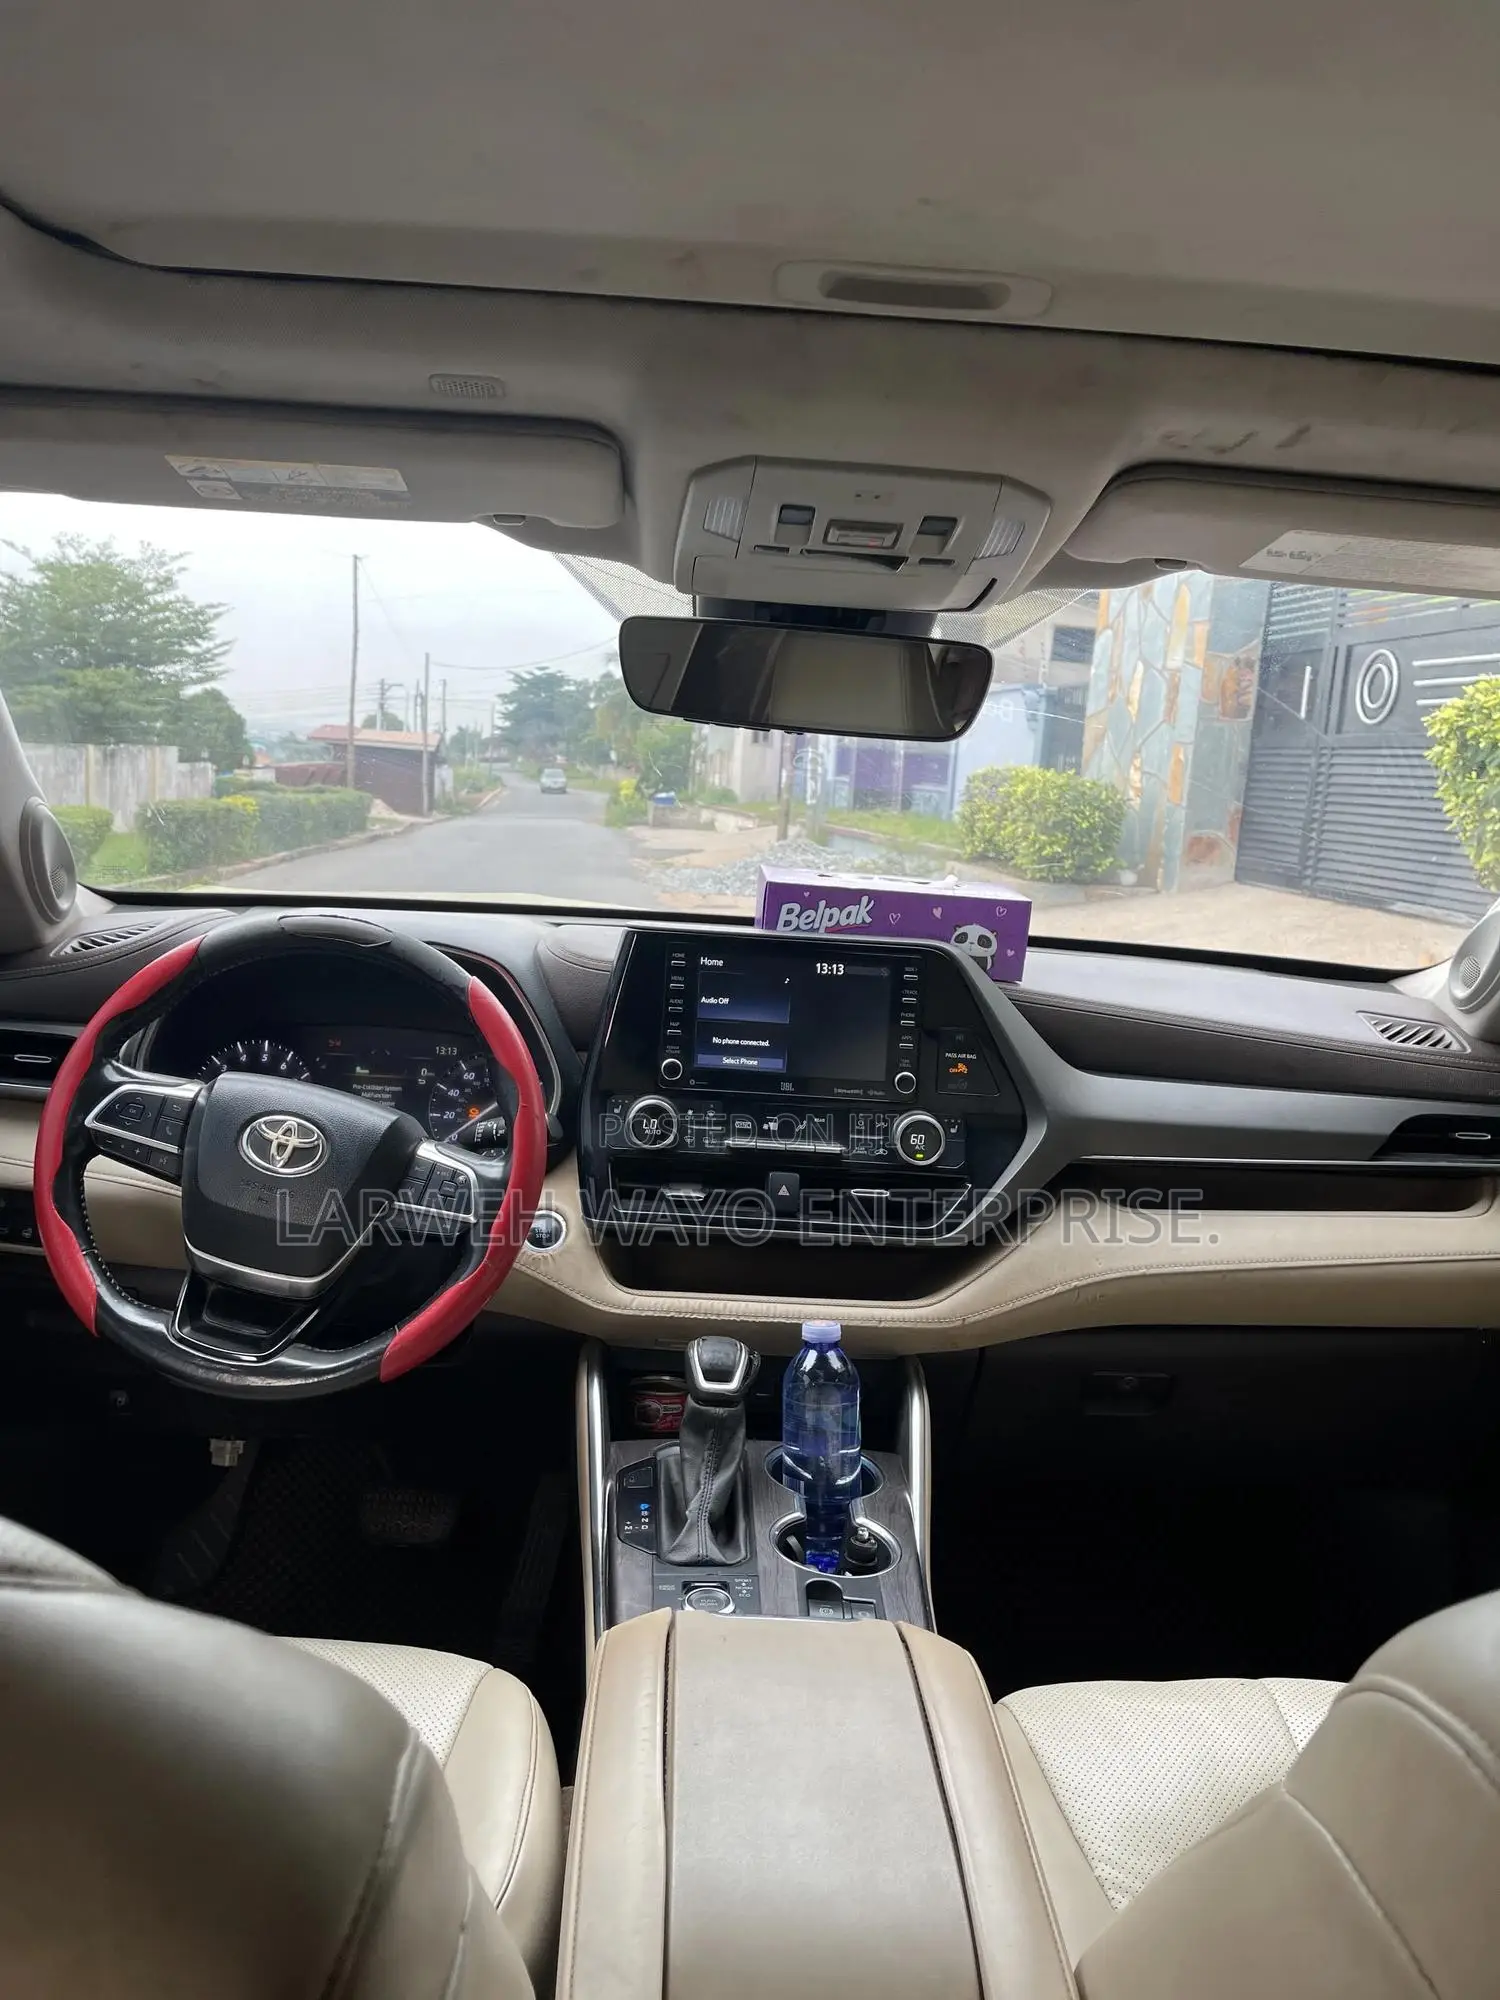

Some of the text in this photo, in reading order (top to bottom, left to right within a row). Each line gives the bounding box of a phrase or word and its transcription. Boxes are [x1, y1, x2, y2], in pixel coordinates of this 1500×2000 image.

[776, 896, 874, 933] Belpak
[700, 957, 723, 967] Home
[816, 962, 845, 975] 13:13
[701, 996, 718, 1004] Audio
[712, 1036, 770, 1047] No phone connected.
[435, 1046, 458, 1056] 13:13
[261, 1053, 268, 1062] 5
[722, 1057, 758, 1065] Select Phone
[280, 1062, 287, 1070] 6
[463, 1072, 476, 1080] 60
[446, 1089, 460, 1097] 40
[443, 1111, 455, 1119] 20
[910, 1134, 925, 1145] 60
